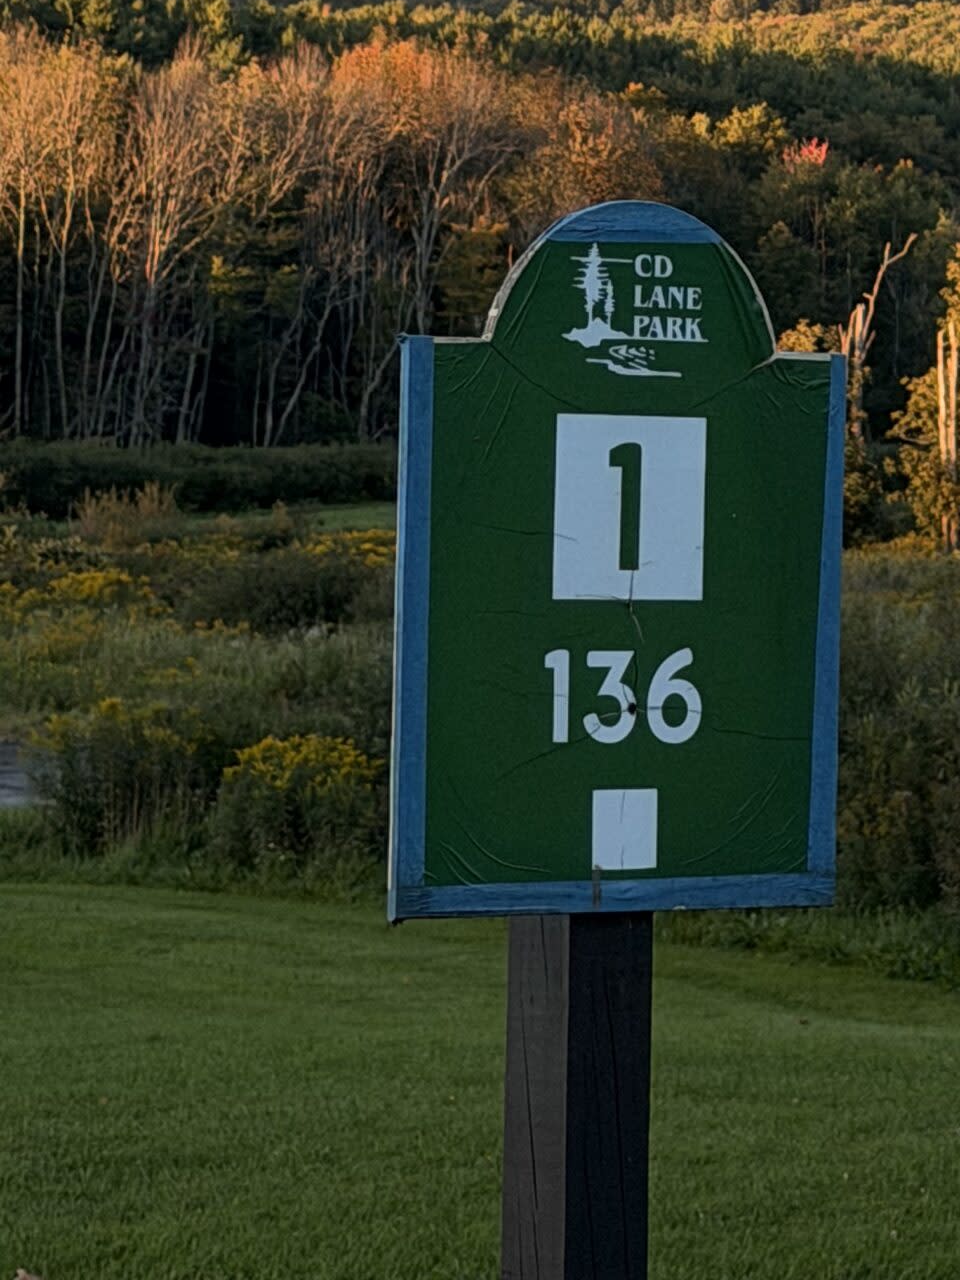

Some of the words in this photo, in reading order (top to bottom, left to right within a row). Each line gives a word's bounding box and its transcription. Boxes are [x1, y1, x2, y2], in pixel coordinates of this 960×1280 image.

[634, 254, 673, 278] CD
[633, 285, 703, 310] LANE
[633, 315, 703, 340] PARK
[608, 442, 642, 571] 1
[544, 647, 703, 745] 136
